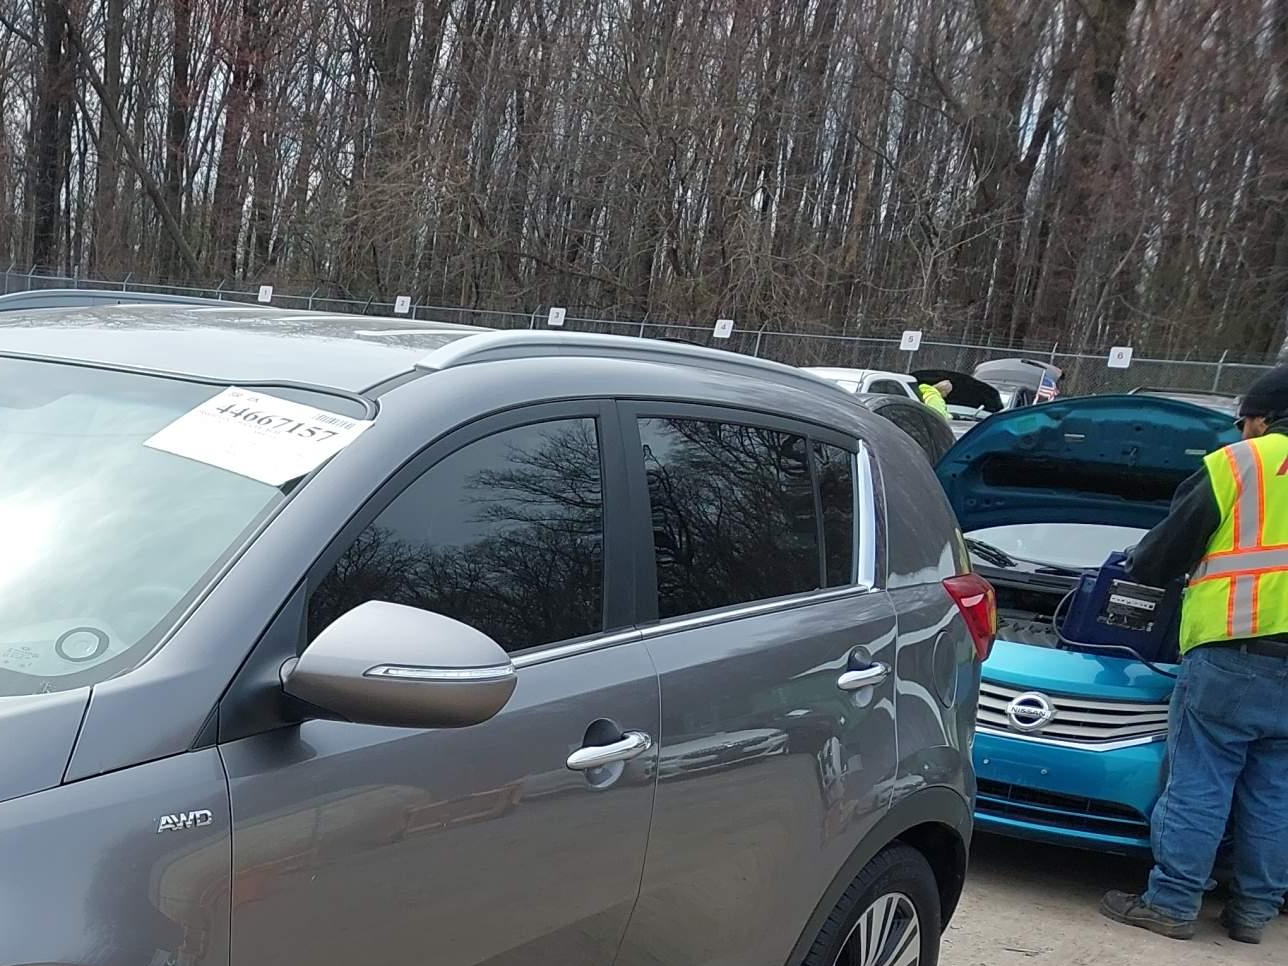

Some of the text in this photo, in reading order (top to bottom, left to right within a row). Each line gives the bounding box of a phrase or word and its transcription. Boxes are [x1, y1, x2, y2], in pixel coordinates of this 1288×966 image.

[1117, 352, 1124, 360] 6
[215, 403, 340, 443] 44667157
[158, 809, 212, 833] AWD
